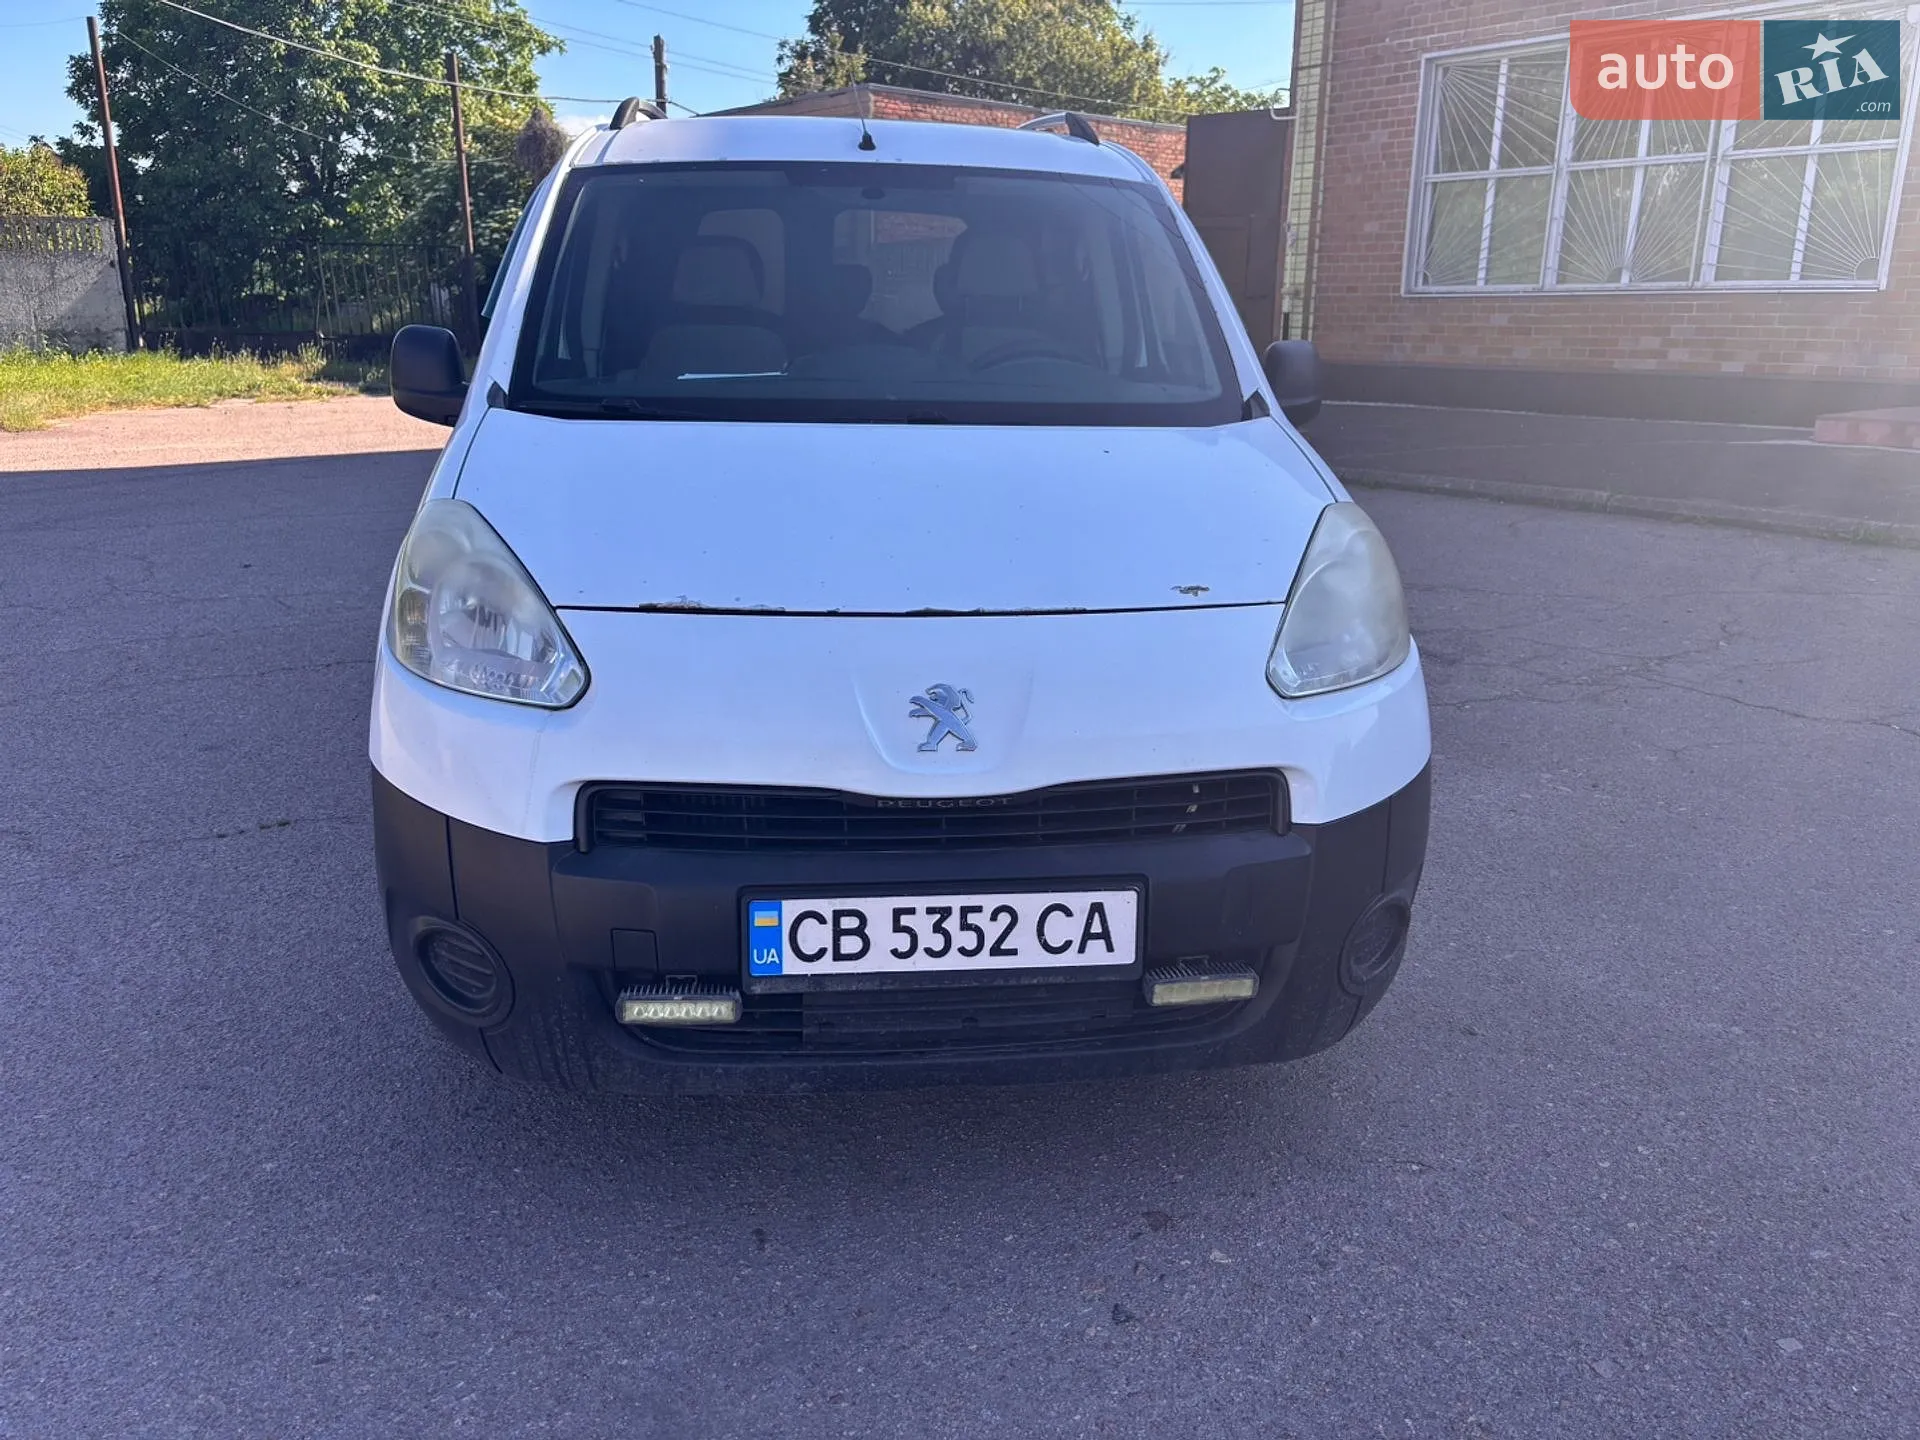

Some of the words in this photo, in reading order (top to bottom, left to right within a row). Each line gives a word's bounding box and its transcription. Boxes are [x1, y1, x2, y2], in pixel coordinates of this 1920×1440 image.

[877, 797, 1013, 808] PEUGEOT
[788, 908, 871, 962] CB
[889, 905, 1019, 959] 5352
[1036, 901, 1115, 955] CA
[754, 948, 779, 964] UA
